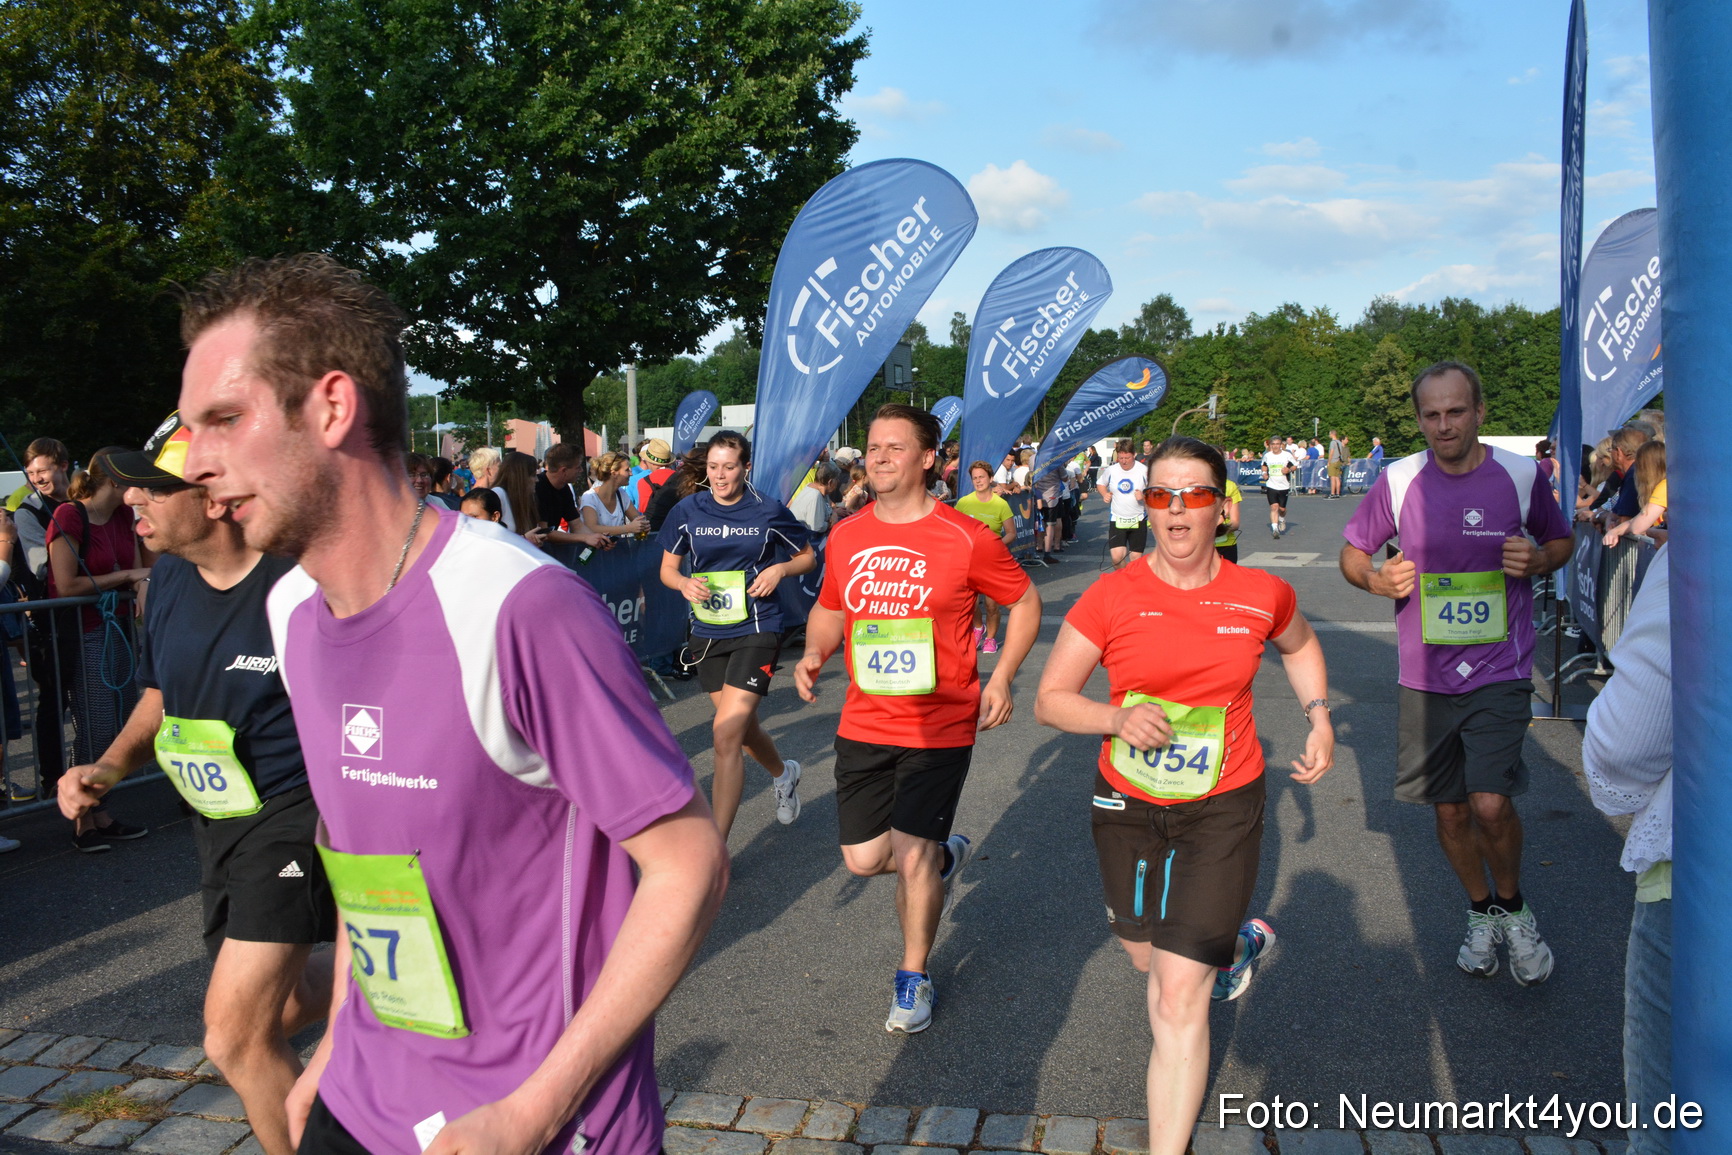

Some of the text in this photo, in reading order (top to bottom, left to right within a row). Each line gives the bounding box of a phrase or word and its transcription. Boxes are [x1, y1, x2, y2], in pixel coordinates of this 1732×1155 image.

[815, 196, 931, 348] Fischer
[856, 225, 944, 347] AUTOMOBILE
[1597, 254, 1661, 361] Fische
[1622, 283, 1662, 361] AUTOMOB
[1001, 271, 1079, 380] Fischer
[1030, 290, 1089, 378] AUTOMOBILE
[684, 398, 708, 434] Fischer
[1054, 391, 1135, 441] Frischmann
[1106, 406, 1126, 420] Druck
[1138, 385, 1163, 403] Medien
[695, 527, 760, 536] EURO POLES
[848, 545, 927, 579] Town &
[844, 571, 933, 613] Country
[868, 601, 910, 617] HAUS
[1438, 600, 1490, 624] 459
[1217, 626, 1250, 634] Michaela
[867, 650, 916, 674] 429
[345, 725, 381, 739] FUCHS
[171, 760, 228, 792] 708
[341, 765, 438, 789] Fertigteilwerke
[1136, 768, 1162, 784] Michaela
